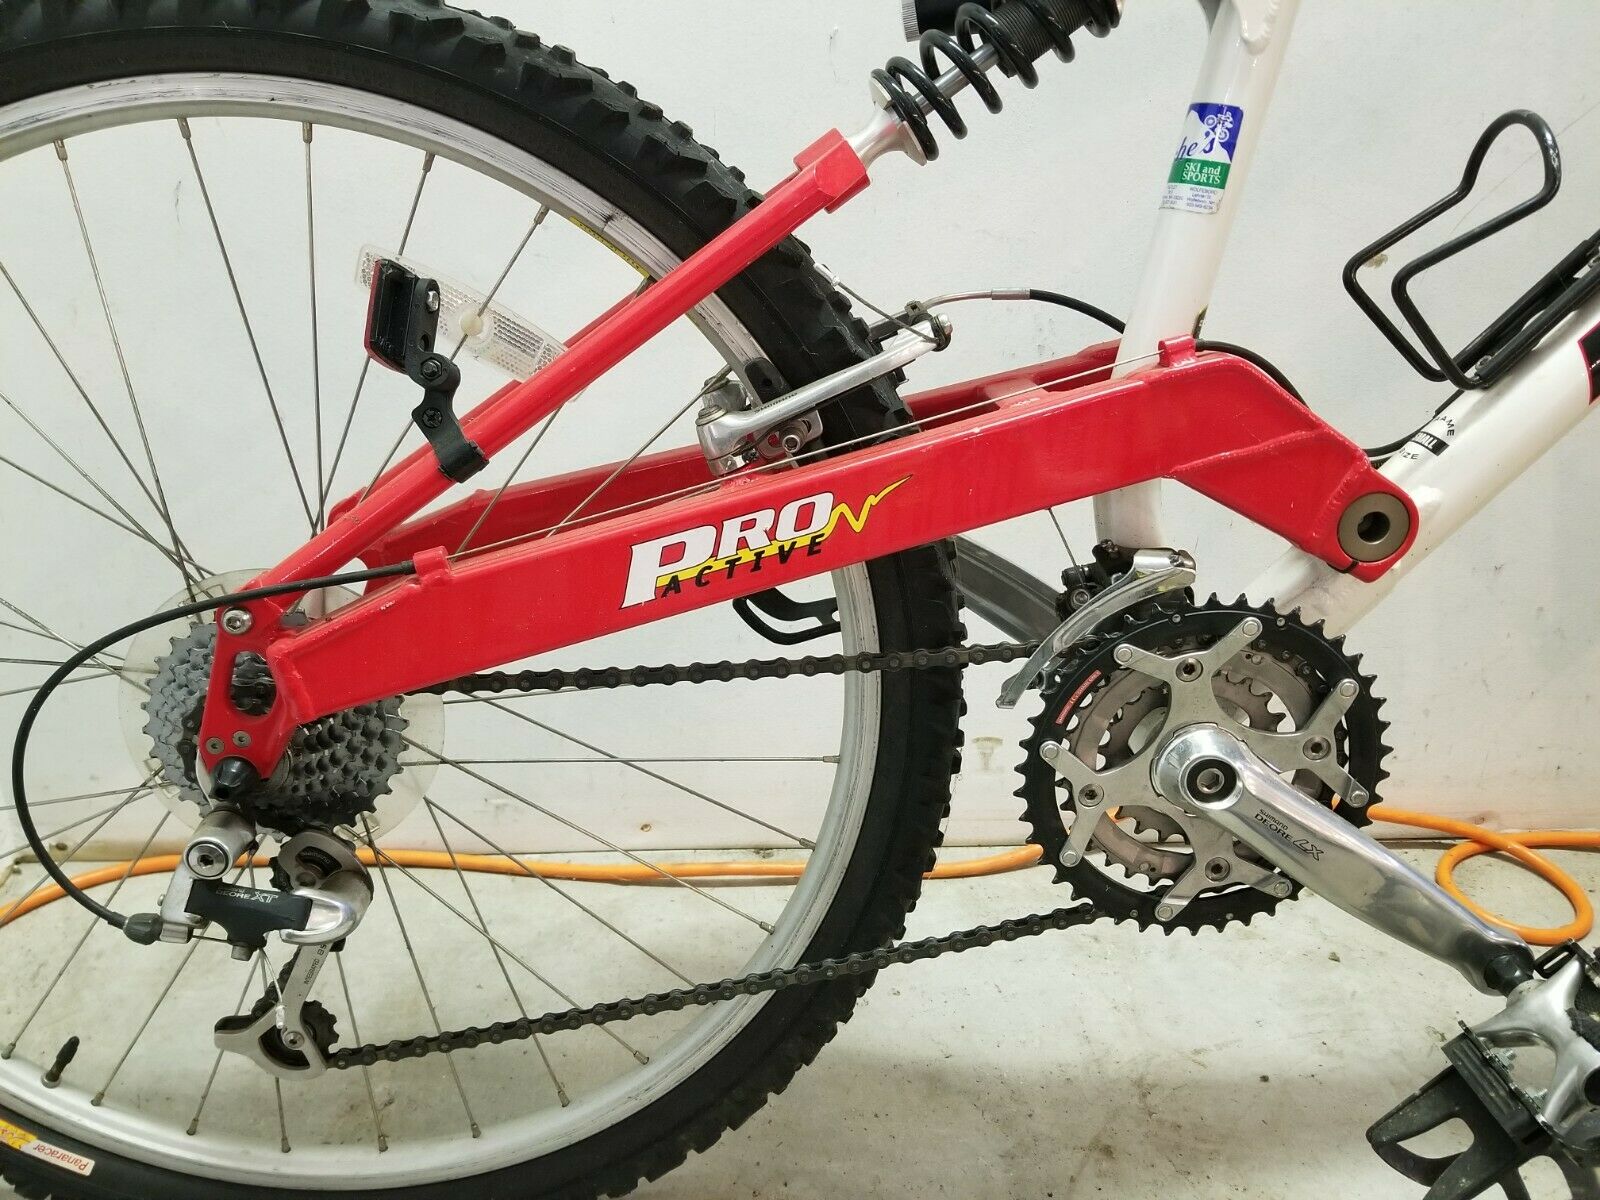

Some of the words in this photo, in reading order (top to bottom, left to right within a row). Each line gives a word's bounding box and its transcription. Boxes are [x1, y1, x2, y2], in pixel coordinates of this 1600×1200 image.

[1181, 171, 1221, 185] SPORTS
[1183, 162, 1201, 172] SKI
[1202, 165, 1221, 175] and
[619, 491, 835, 610] PRO
[661, 532, 826, 598] ACTIVE
[1254, 813, 1294, 841] DEORE
[1292, 839, 1325, 861] LX
[251, 890, 279, 904] XT
[32, 1143, 90, 1172] Panaracer
